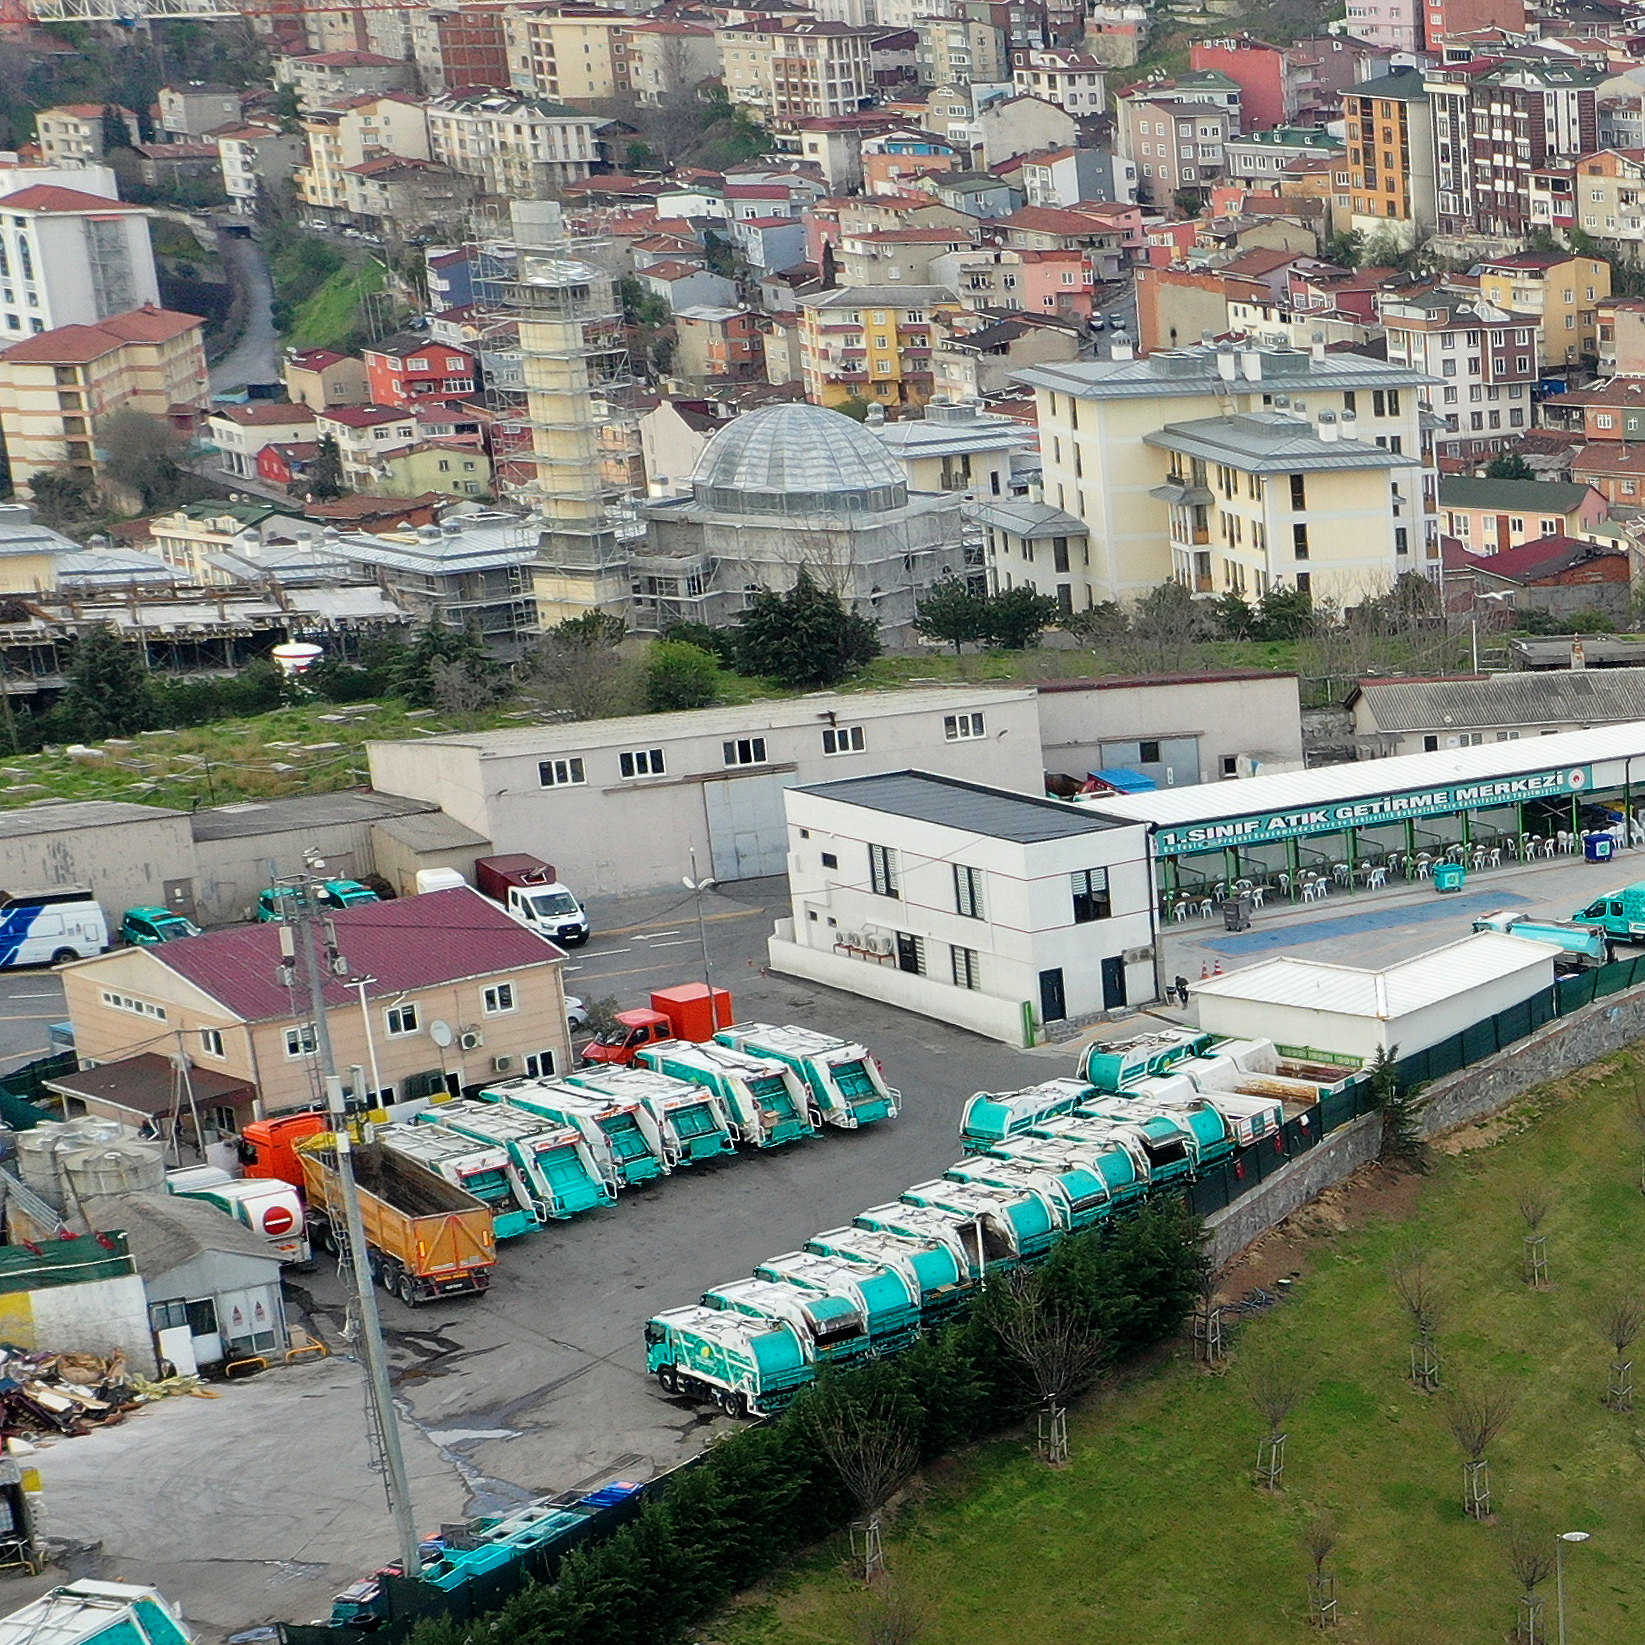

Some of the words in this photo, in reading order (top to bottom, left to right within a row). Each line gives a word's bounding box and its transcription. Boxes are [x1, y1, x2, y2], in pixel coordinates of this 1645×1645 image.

[1162, 820, 1261, 846] 1.SINIF
[1267, 809, 1328, 831] ATIK
[1335, 792, 1449, 819] GETİRME
[1456, 771, 1564, 800] MERKEZİ
